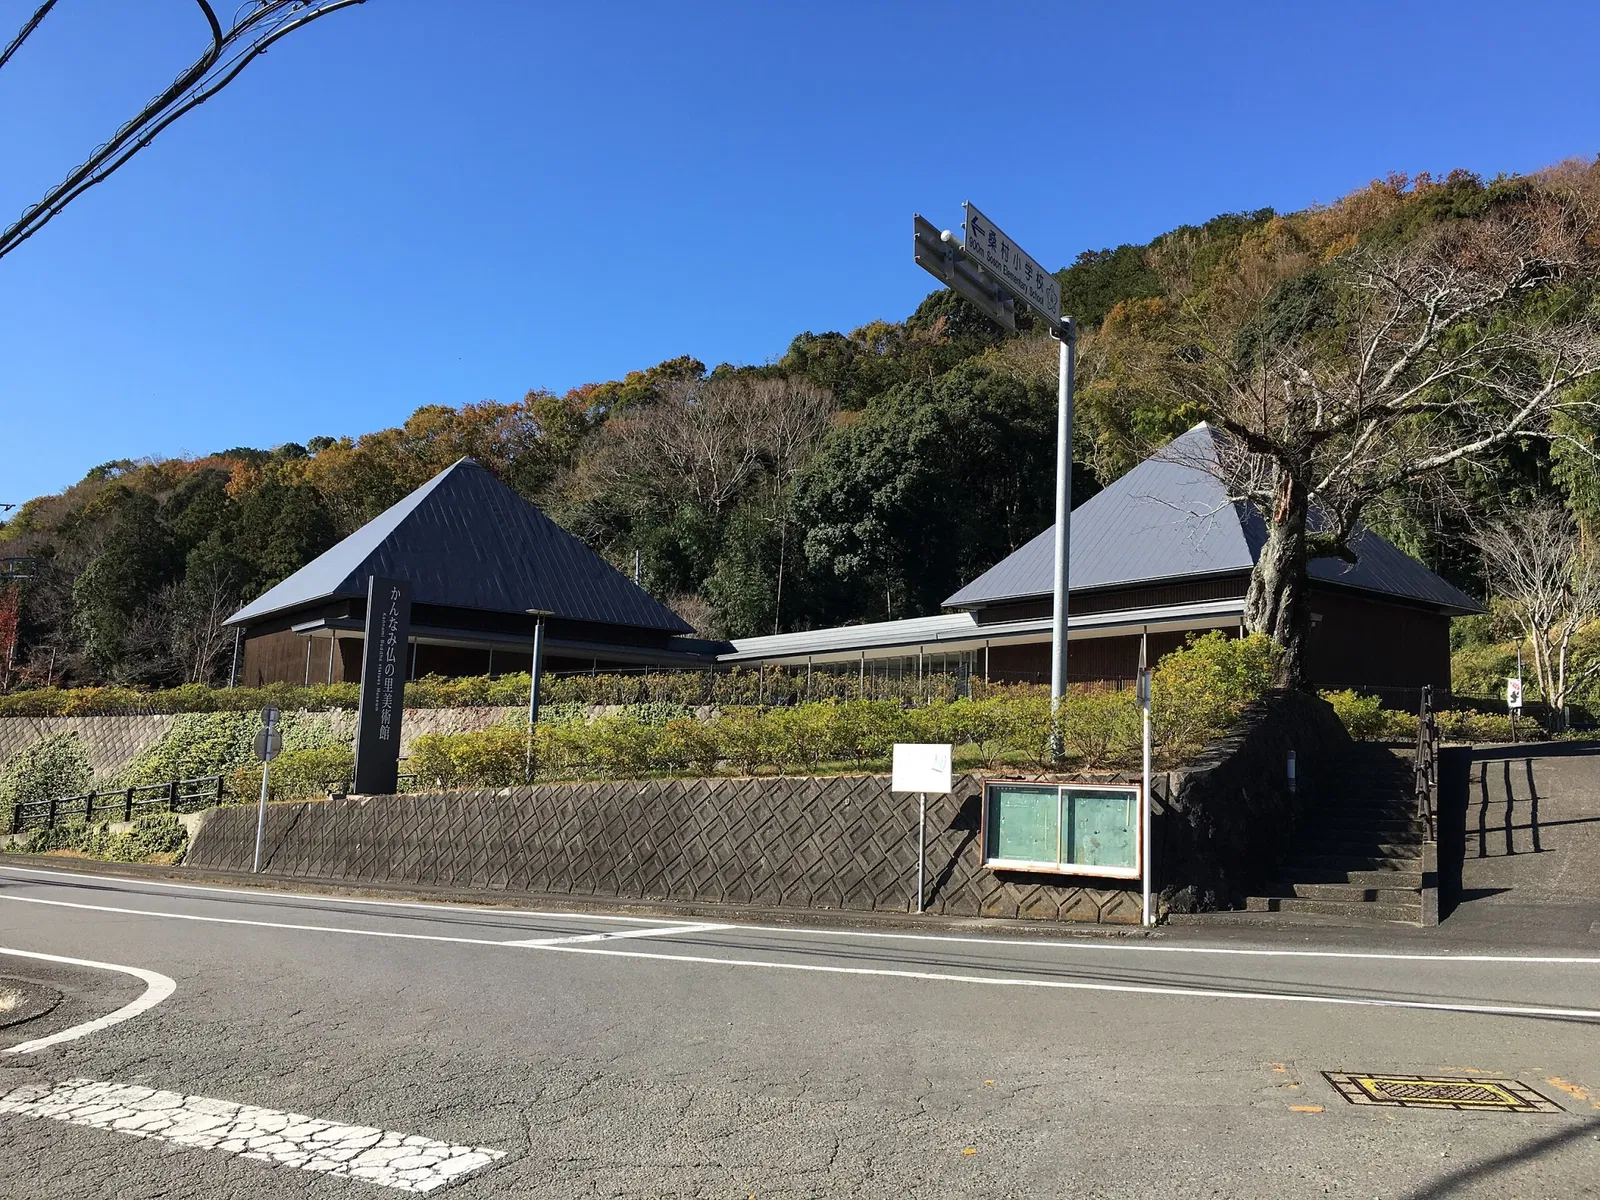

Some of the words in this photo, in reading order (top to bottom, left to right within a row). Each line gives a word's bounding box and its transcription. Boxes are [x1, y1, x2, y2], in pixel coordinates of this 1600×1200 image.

[988, 229, 1044, 292] 桑村小学校
[1003, 264, 1027, 293] Elementary
[1030, 287, 1044, 305] School
[379, 587, 401, 740] かんなみ仏の里美術館
